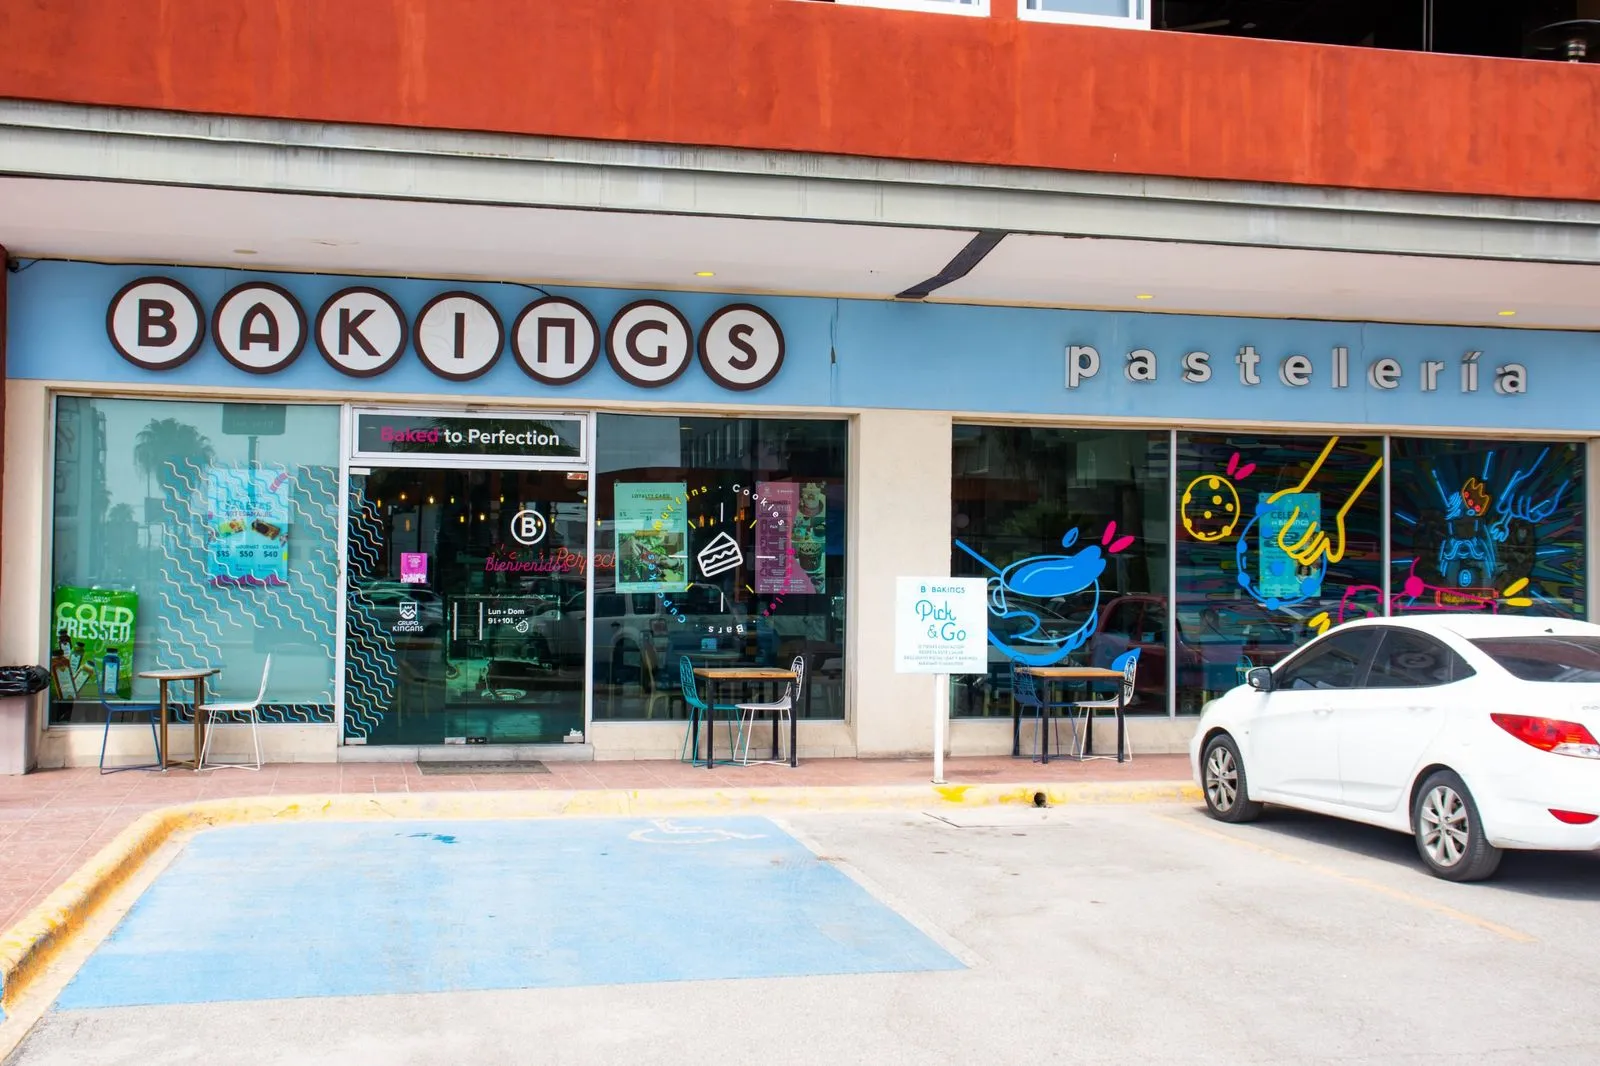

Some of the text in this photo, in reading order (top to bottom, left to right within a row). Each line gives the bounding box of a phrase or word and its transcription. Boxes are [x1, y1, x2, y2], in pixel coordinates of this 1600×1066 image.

[137, 298, 757, 371] BAKINGS
[1065, 344, 1529, 395] pastelería
[380, 426, 560, 446] Baked to Perfection
[732, 483, 784, 526] Cookies
[1271, 511, 1309, 519] CELERA
[485, 555, 571, 573] Bienvenidos
[649, 553, 686, 623] Cupckes
[931, 586, 966, 594] BAKINGS
[56, 601, 134, 627] COLD
[915, 599, 957, 622] Pick
[56, 617, 131, 643] PRESSED
[708, 624, 745, 635] Bars
[927, 621, 967, 641] & Go
